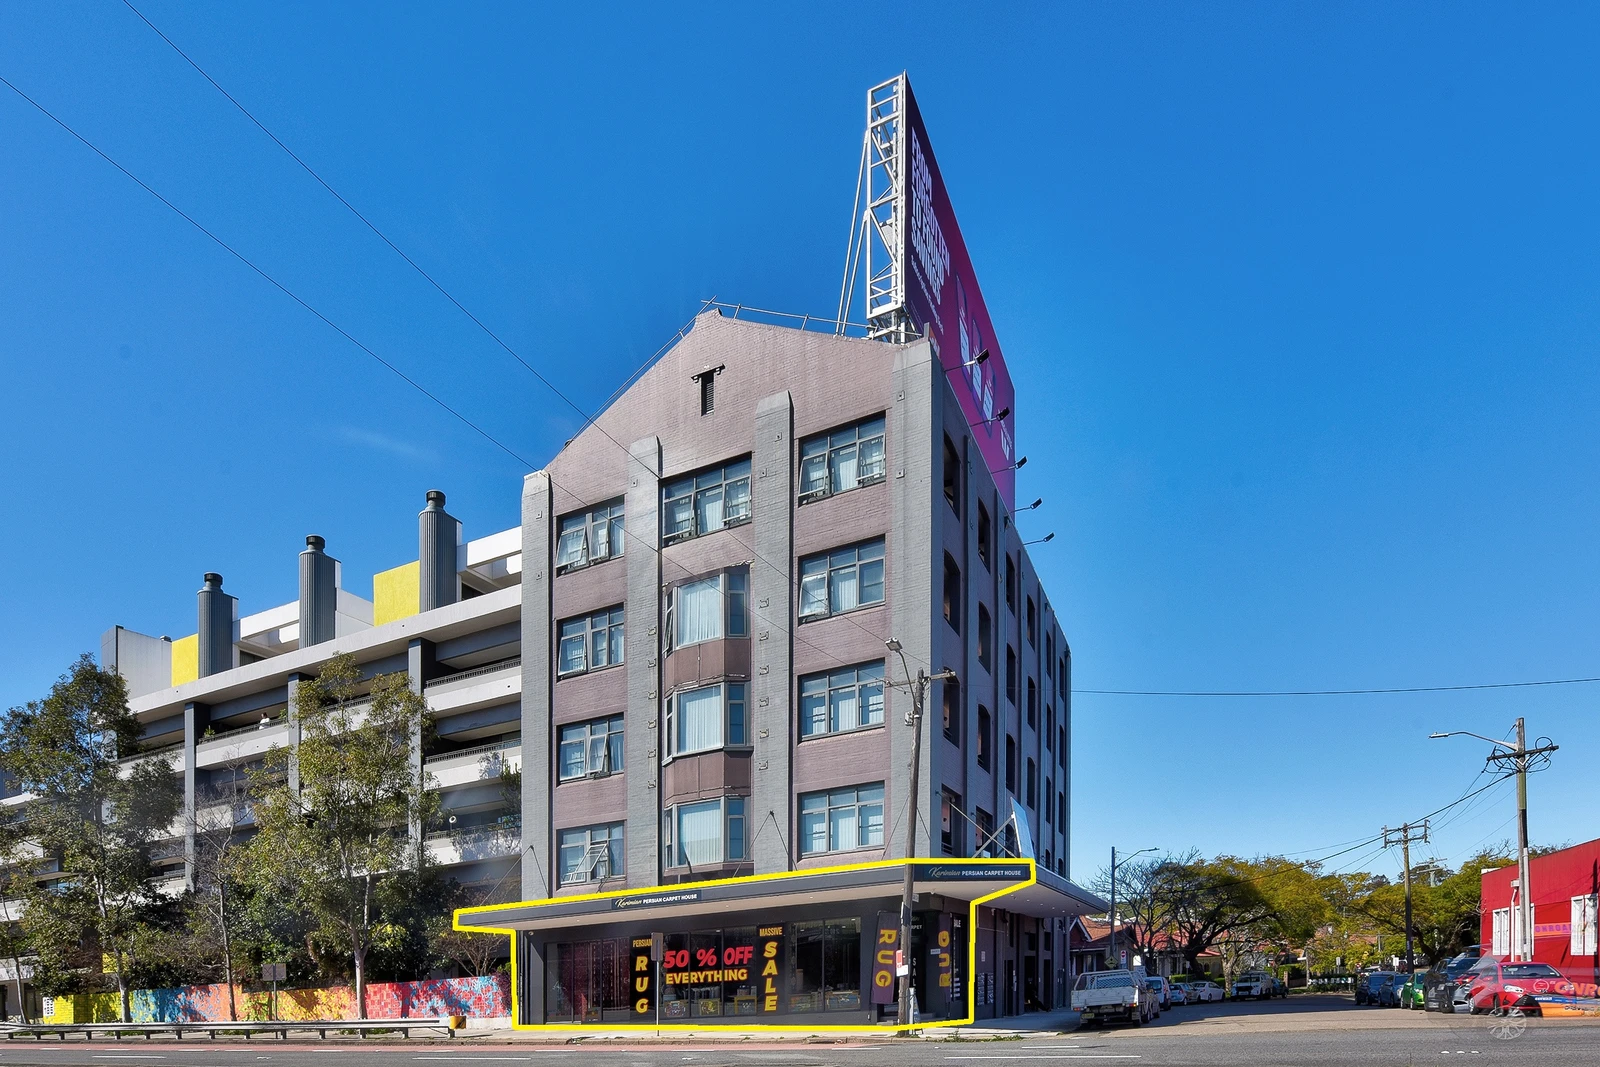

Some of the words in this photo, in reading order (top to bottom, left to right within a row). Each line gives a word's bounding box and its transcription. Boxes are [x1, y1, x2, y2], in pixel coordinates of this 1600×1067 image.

[911, 126, 933, 202] FROM
[911, 155, 950, 277] FORGOTTEN
[911, 184, 922, 229] TO
[922, 212, 945, 286] FOUND
[911, 215, 941, 306] SAVINGS
[663, 949, 690, 969] 50
[696, 947, 717, 967] %
[723, 945, 754, 966] OFF
[759, 926, 783, 937] MASSIVE
[875, 929, 898, 987] RUG
[1535, 924, 1572, 933] ONROA
[635, 955, 649, 1014] RUG
[665, 968, 748, 985] EVERYTHING
[762, 941, 779, 1012] SALE
